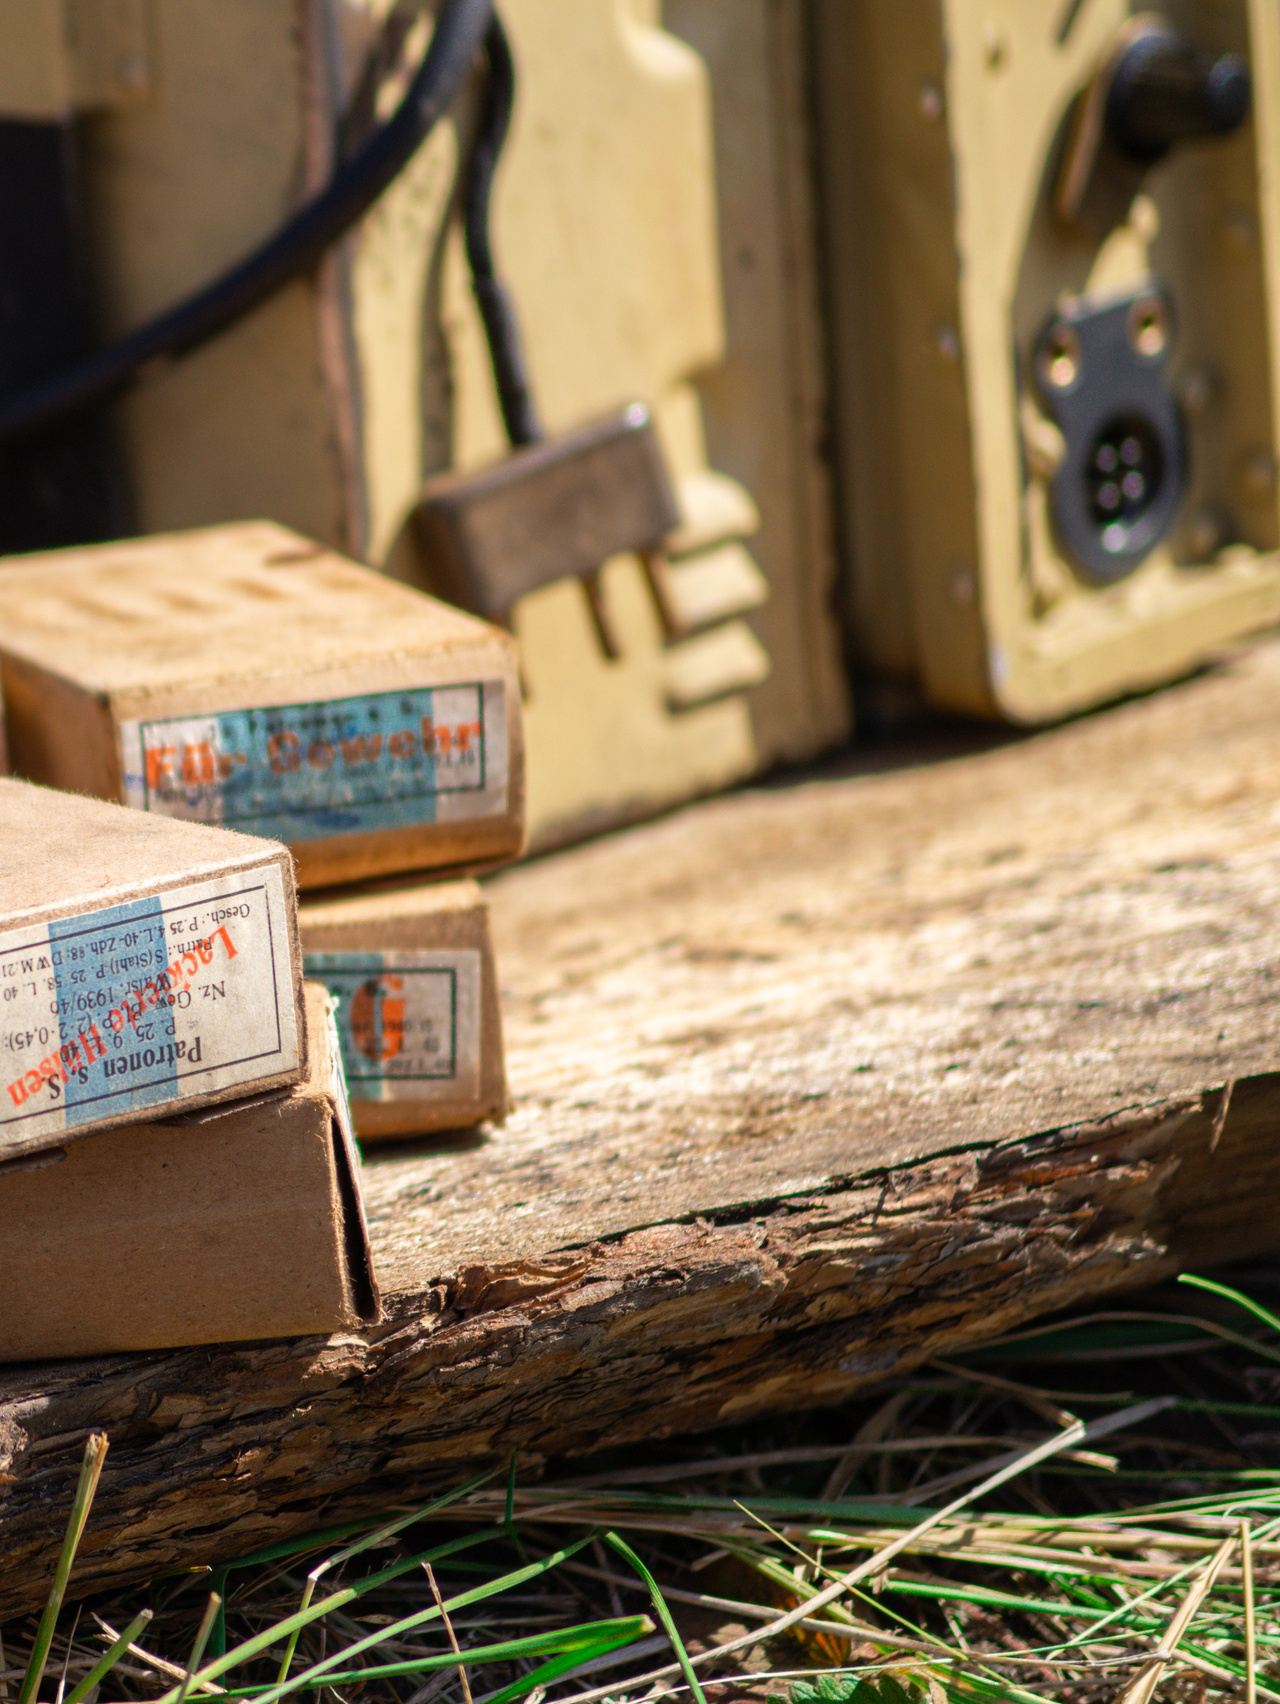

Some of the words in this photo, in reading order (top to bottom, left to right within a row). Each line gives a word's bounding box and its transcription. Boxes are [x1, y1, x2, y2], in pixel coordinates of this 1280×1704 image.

[70, 969, 87, 985] 25
[91, 963, 107, 980] P.
[106, 925, 239, 1033] Lackierte
[2, 985, 19, 1003] 40
[22, 981, 37, 997] L.
[198, 980, 226, 1001] Nz.
[49, 985, 115, 1020] 1939/46
[96, 1009, 115, 1030] P.
[159, 1016, 176, 1036] P.
[106, 1030, 123, 1050] 9.
[134, 1022, 155, 1044] 25
[59, 1042, 79, 1064] 40
[84, 1034, 102, 1055] L.
[6, 1022, 109, 1108] Hülsen
[102, 1035, 203, 1079] Patronen
[70, 1065, 89, 1086] s.
[41, 1072, 62, 1101] S.
